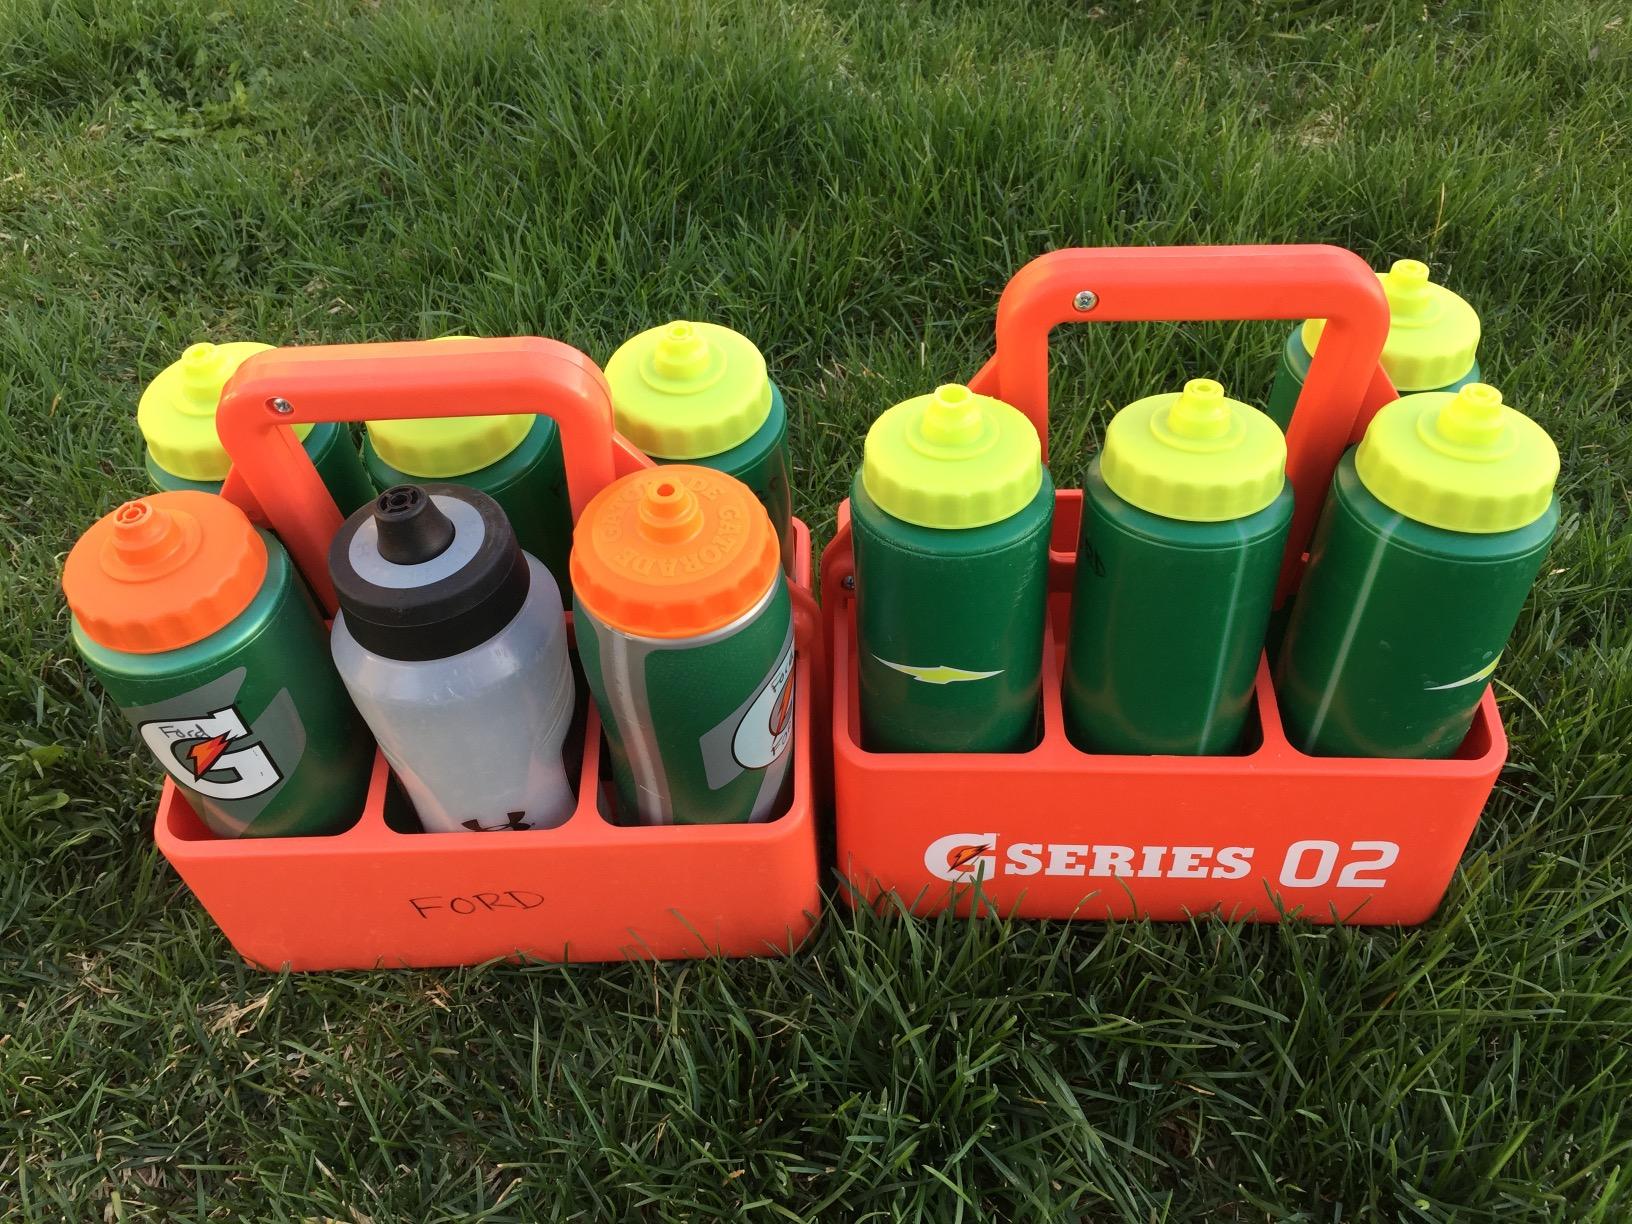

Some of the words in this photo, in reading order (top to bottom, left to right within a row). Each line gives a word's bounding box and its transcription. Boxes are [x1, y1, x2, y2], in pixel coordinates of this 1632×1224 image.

[158, 723, 211, 740] Ford
[1004, 842, 1255, 881] SERIES
[1278, 839, 1400, 889] 02
[408, 890, 545, 920] FORD
